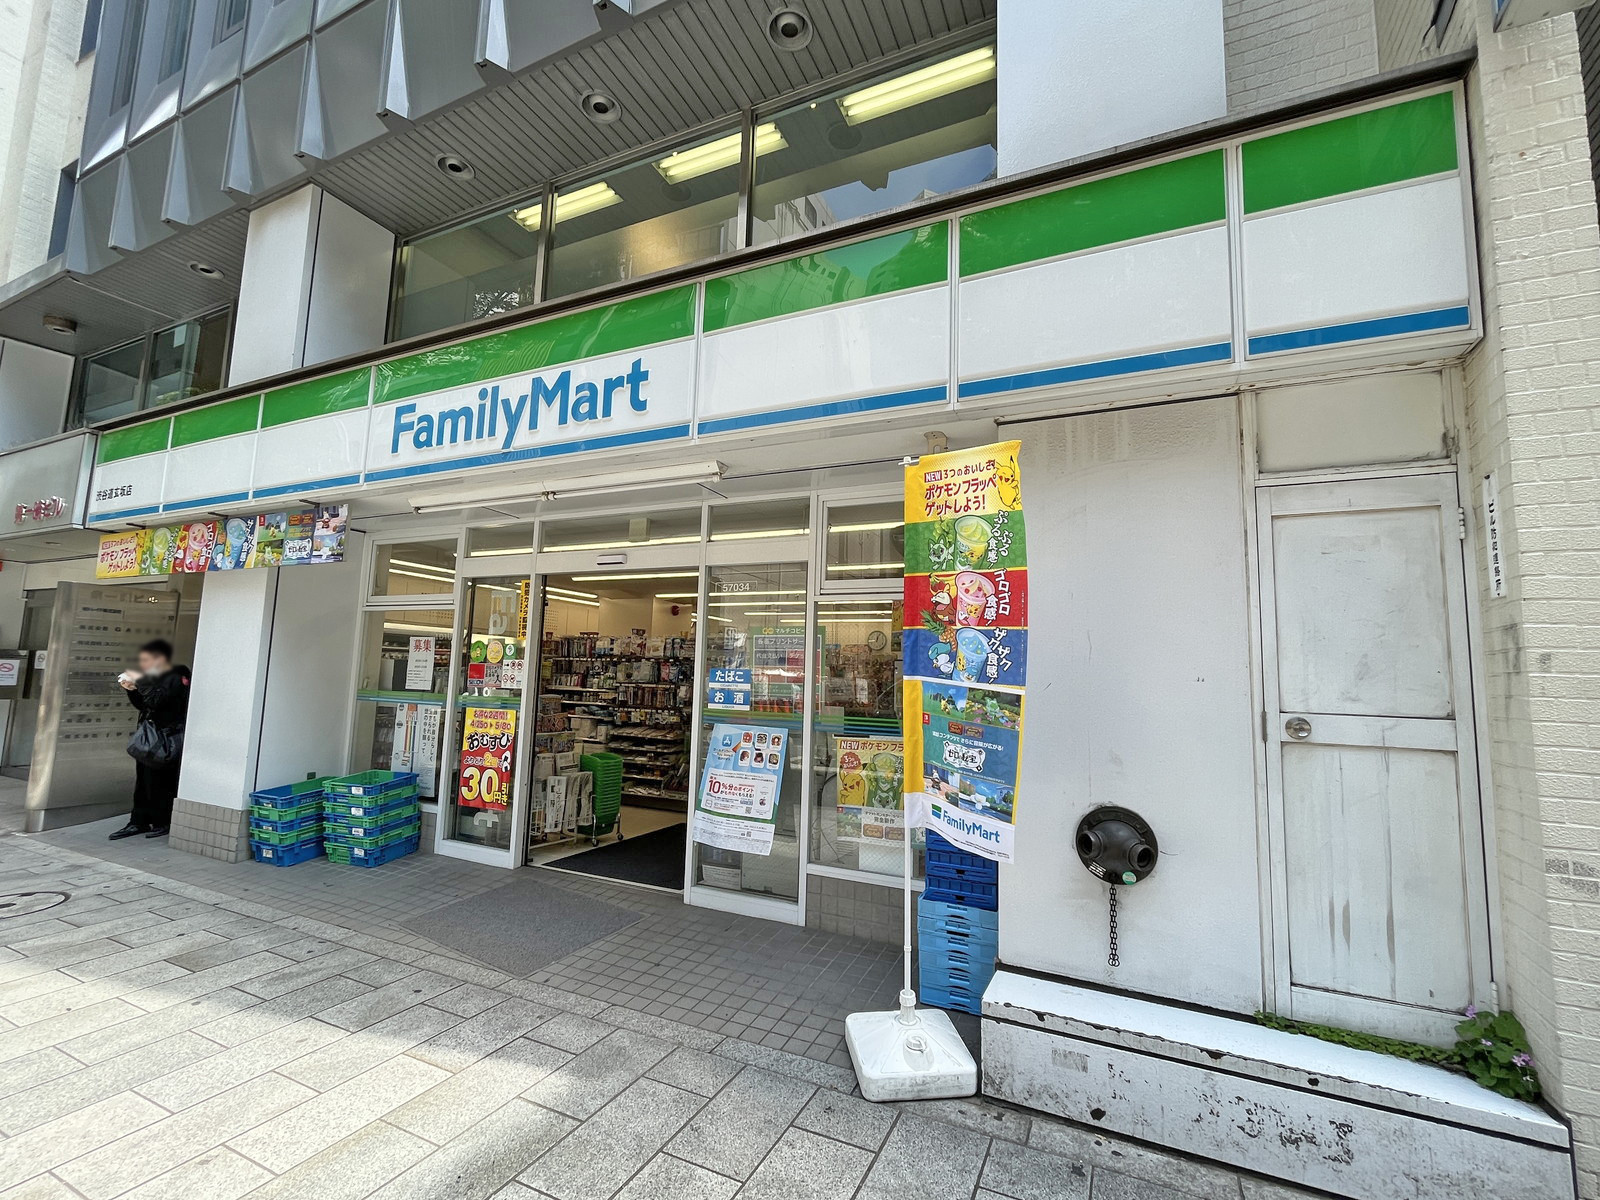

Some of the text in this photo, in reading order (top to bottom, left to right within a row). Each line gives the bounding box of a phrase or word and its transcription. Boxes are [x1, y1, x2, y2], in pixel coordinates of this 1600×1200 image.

[391, 358, 650, 454] FamilyMart
[924, 471, 943, 483] NEW
[925, 474, 998, 500] ポケモンフラッペ
[925, 494, 986, 517] ゲットしよう!
[722, 583, 750, 592] 57034
[994, 569, 1011, 616] ゴロゴロ
[414, 639, 432, 653] 募集
[715, 670, 744, 682] たばこ
[840, 741, 859, 750] NEW
[943, 810, 1000, 843] FamilyMart
